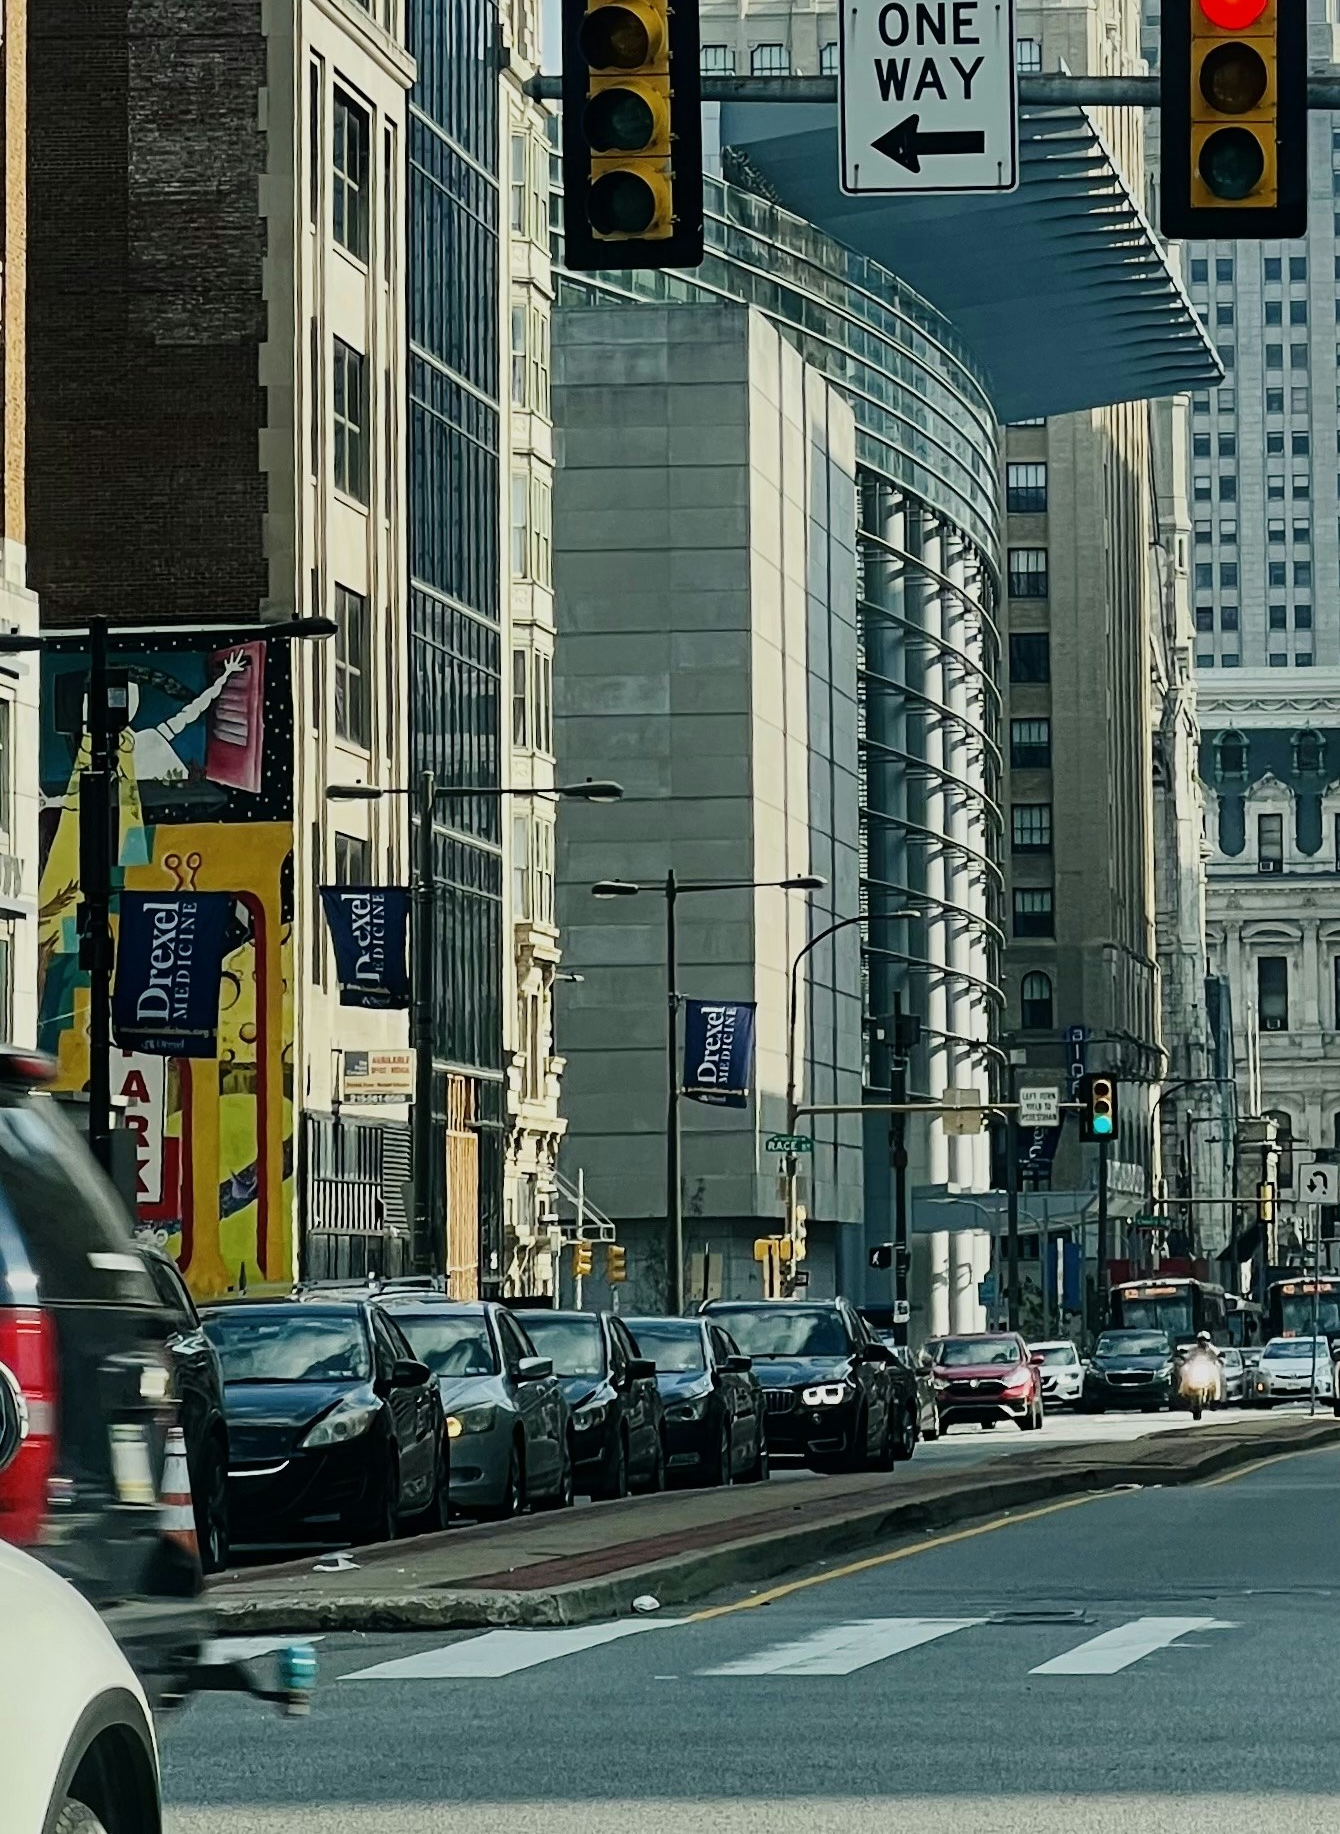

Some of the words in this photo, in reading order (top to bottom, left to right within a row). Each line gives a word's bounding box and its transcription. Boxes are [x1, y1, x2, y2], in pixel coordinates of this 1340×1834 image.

[878, 1, 980, 47] ONE
[874, 56, 985, 101] WAY
[137, 902, 180, 1022] Drexel
[173, 902, 198, 1019] MEDICINE
[371, 894, 385, 972] EDICINE
[697, 1006, 726, 1084] Drexel
[718, 1007, 738, 1084] MEDICINE
[767, 1141, 798, 1151] RACE
